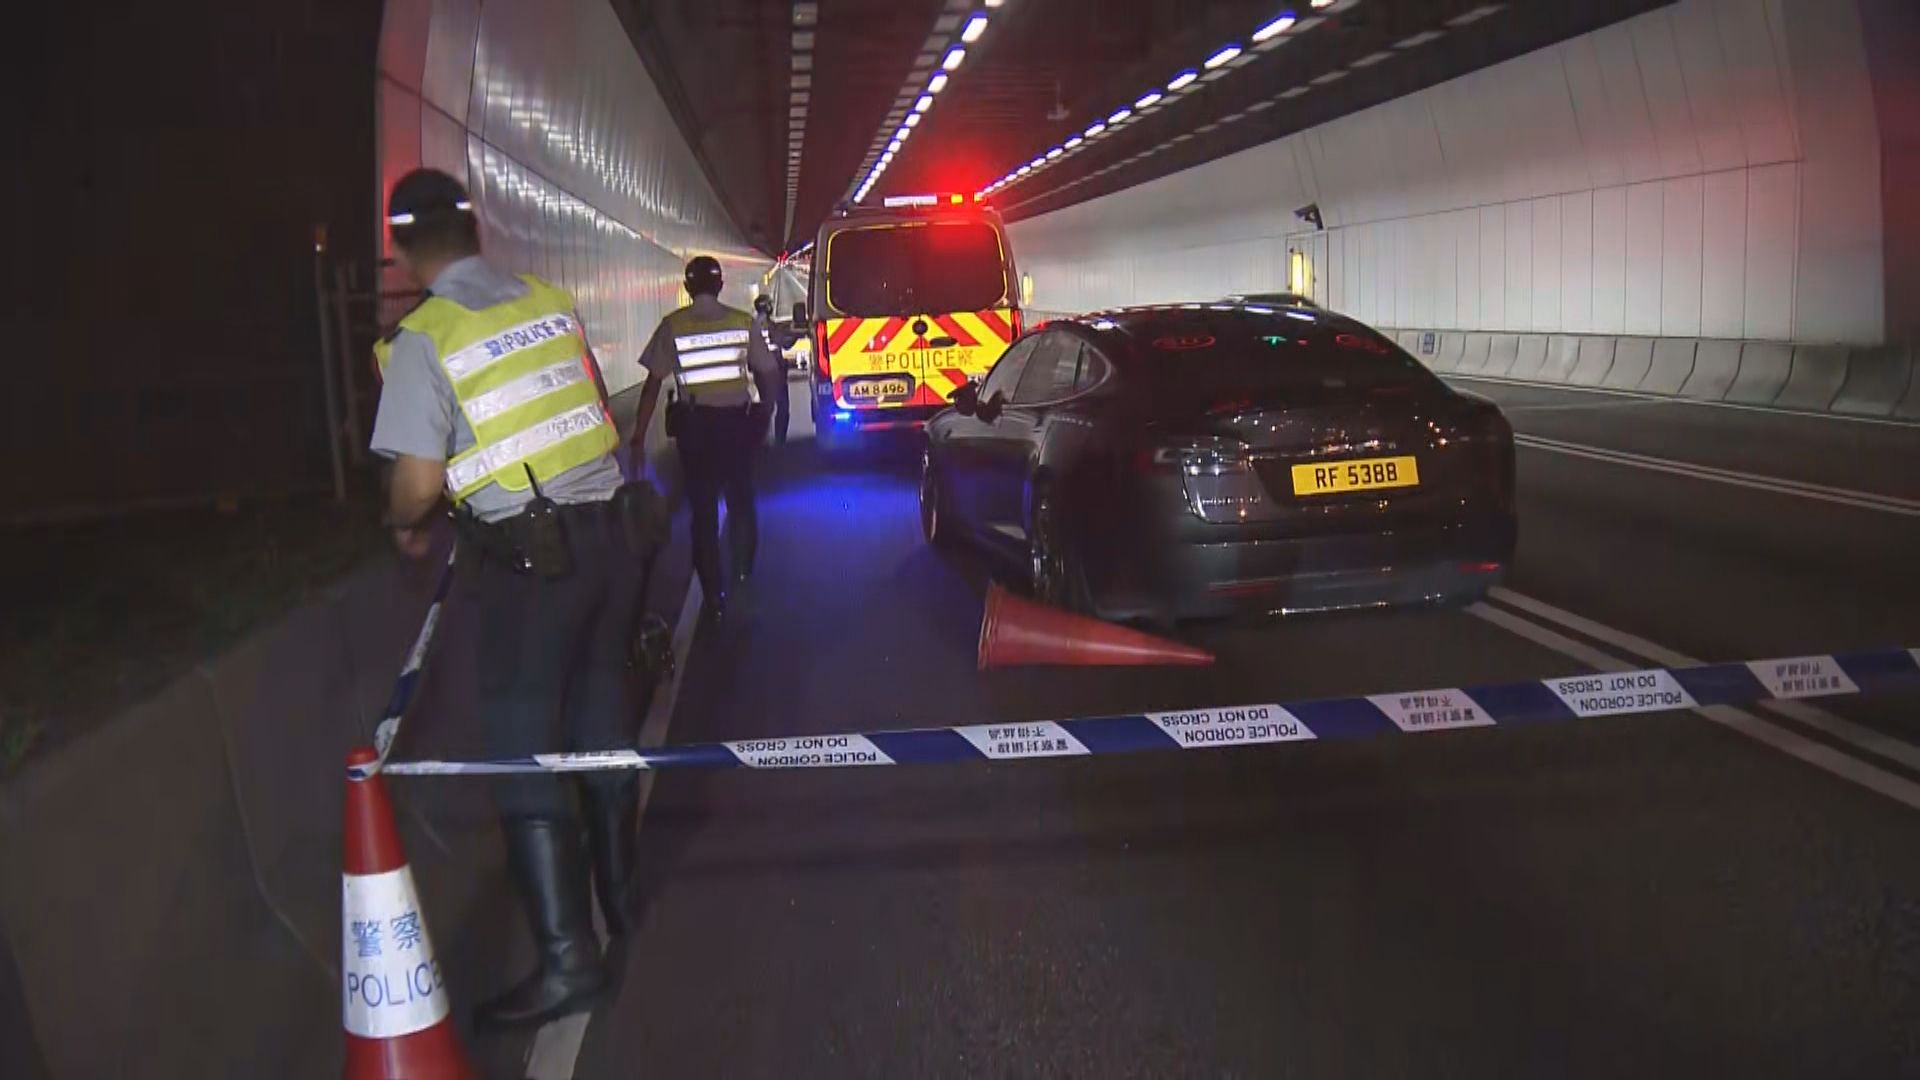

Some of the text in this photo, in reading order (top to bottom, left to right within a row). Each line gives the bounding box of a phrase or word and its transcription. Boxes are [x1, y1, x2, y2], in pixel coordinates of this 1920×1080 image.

[503, 320, 556, 352] POLICE
[886, 349, 956, 369] POLICE
[853, 383, 905, 396] AM 8496
[1315, 462, 1398, 489] RF 5388
[1560, 674, 1656, 695] DO NOT CROSS
[1638, 692, 1682, 706] POLICE
[1161, 708, 1269, 727] DO NOT CROSS
[1249, 723, 1298, 739] POLICE
[736, 737, 848, 752] DO NOT CROSS
[824, 752, 876, 763] POLICE
[351, 911, 421, 958] 警察
